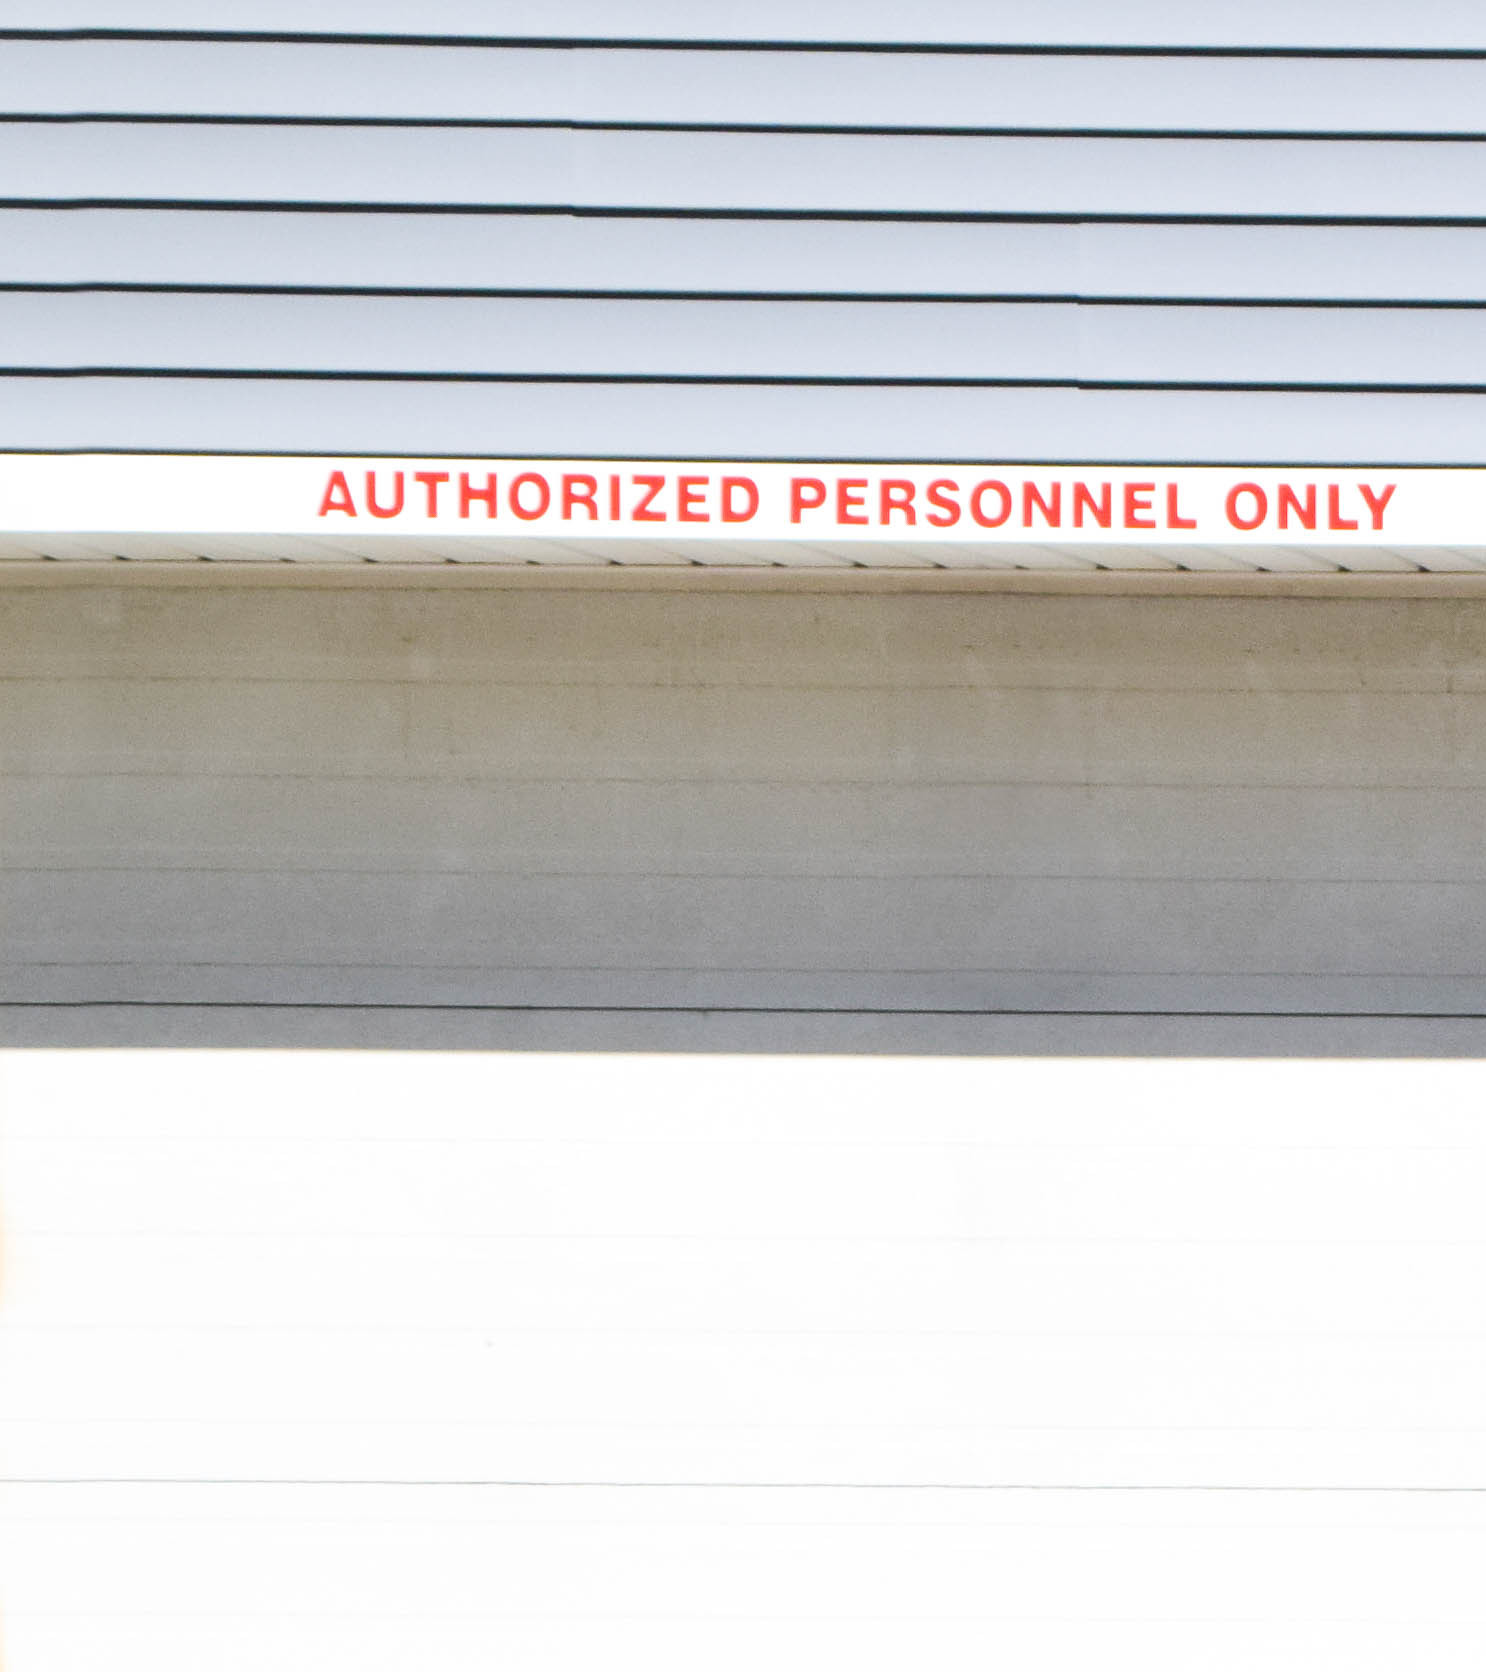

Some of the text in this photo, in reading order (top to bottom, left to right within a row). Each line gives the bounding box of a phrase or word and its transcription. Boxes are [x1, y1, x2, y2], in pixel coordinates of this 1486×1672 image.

[318, 470, 1398, 532] AUTHORIZED PERSONNEL ONLY
